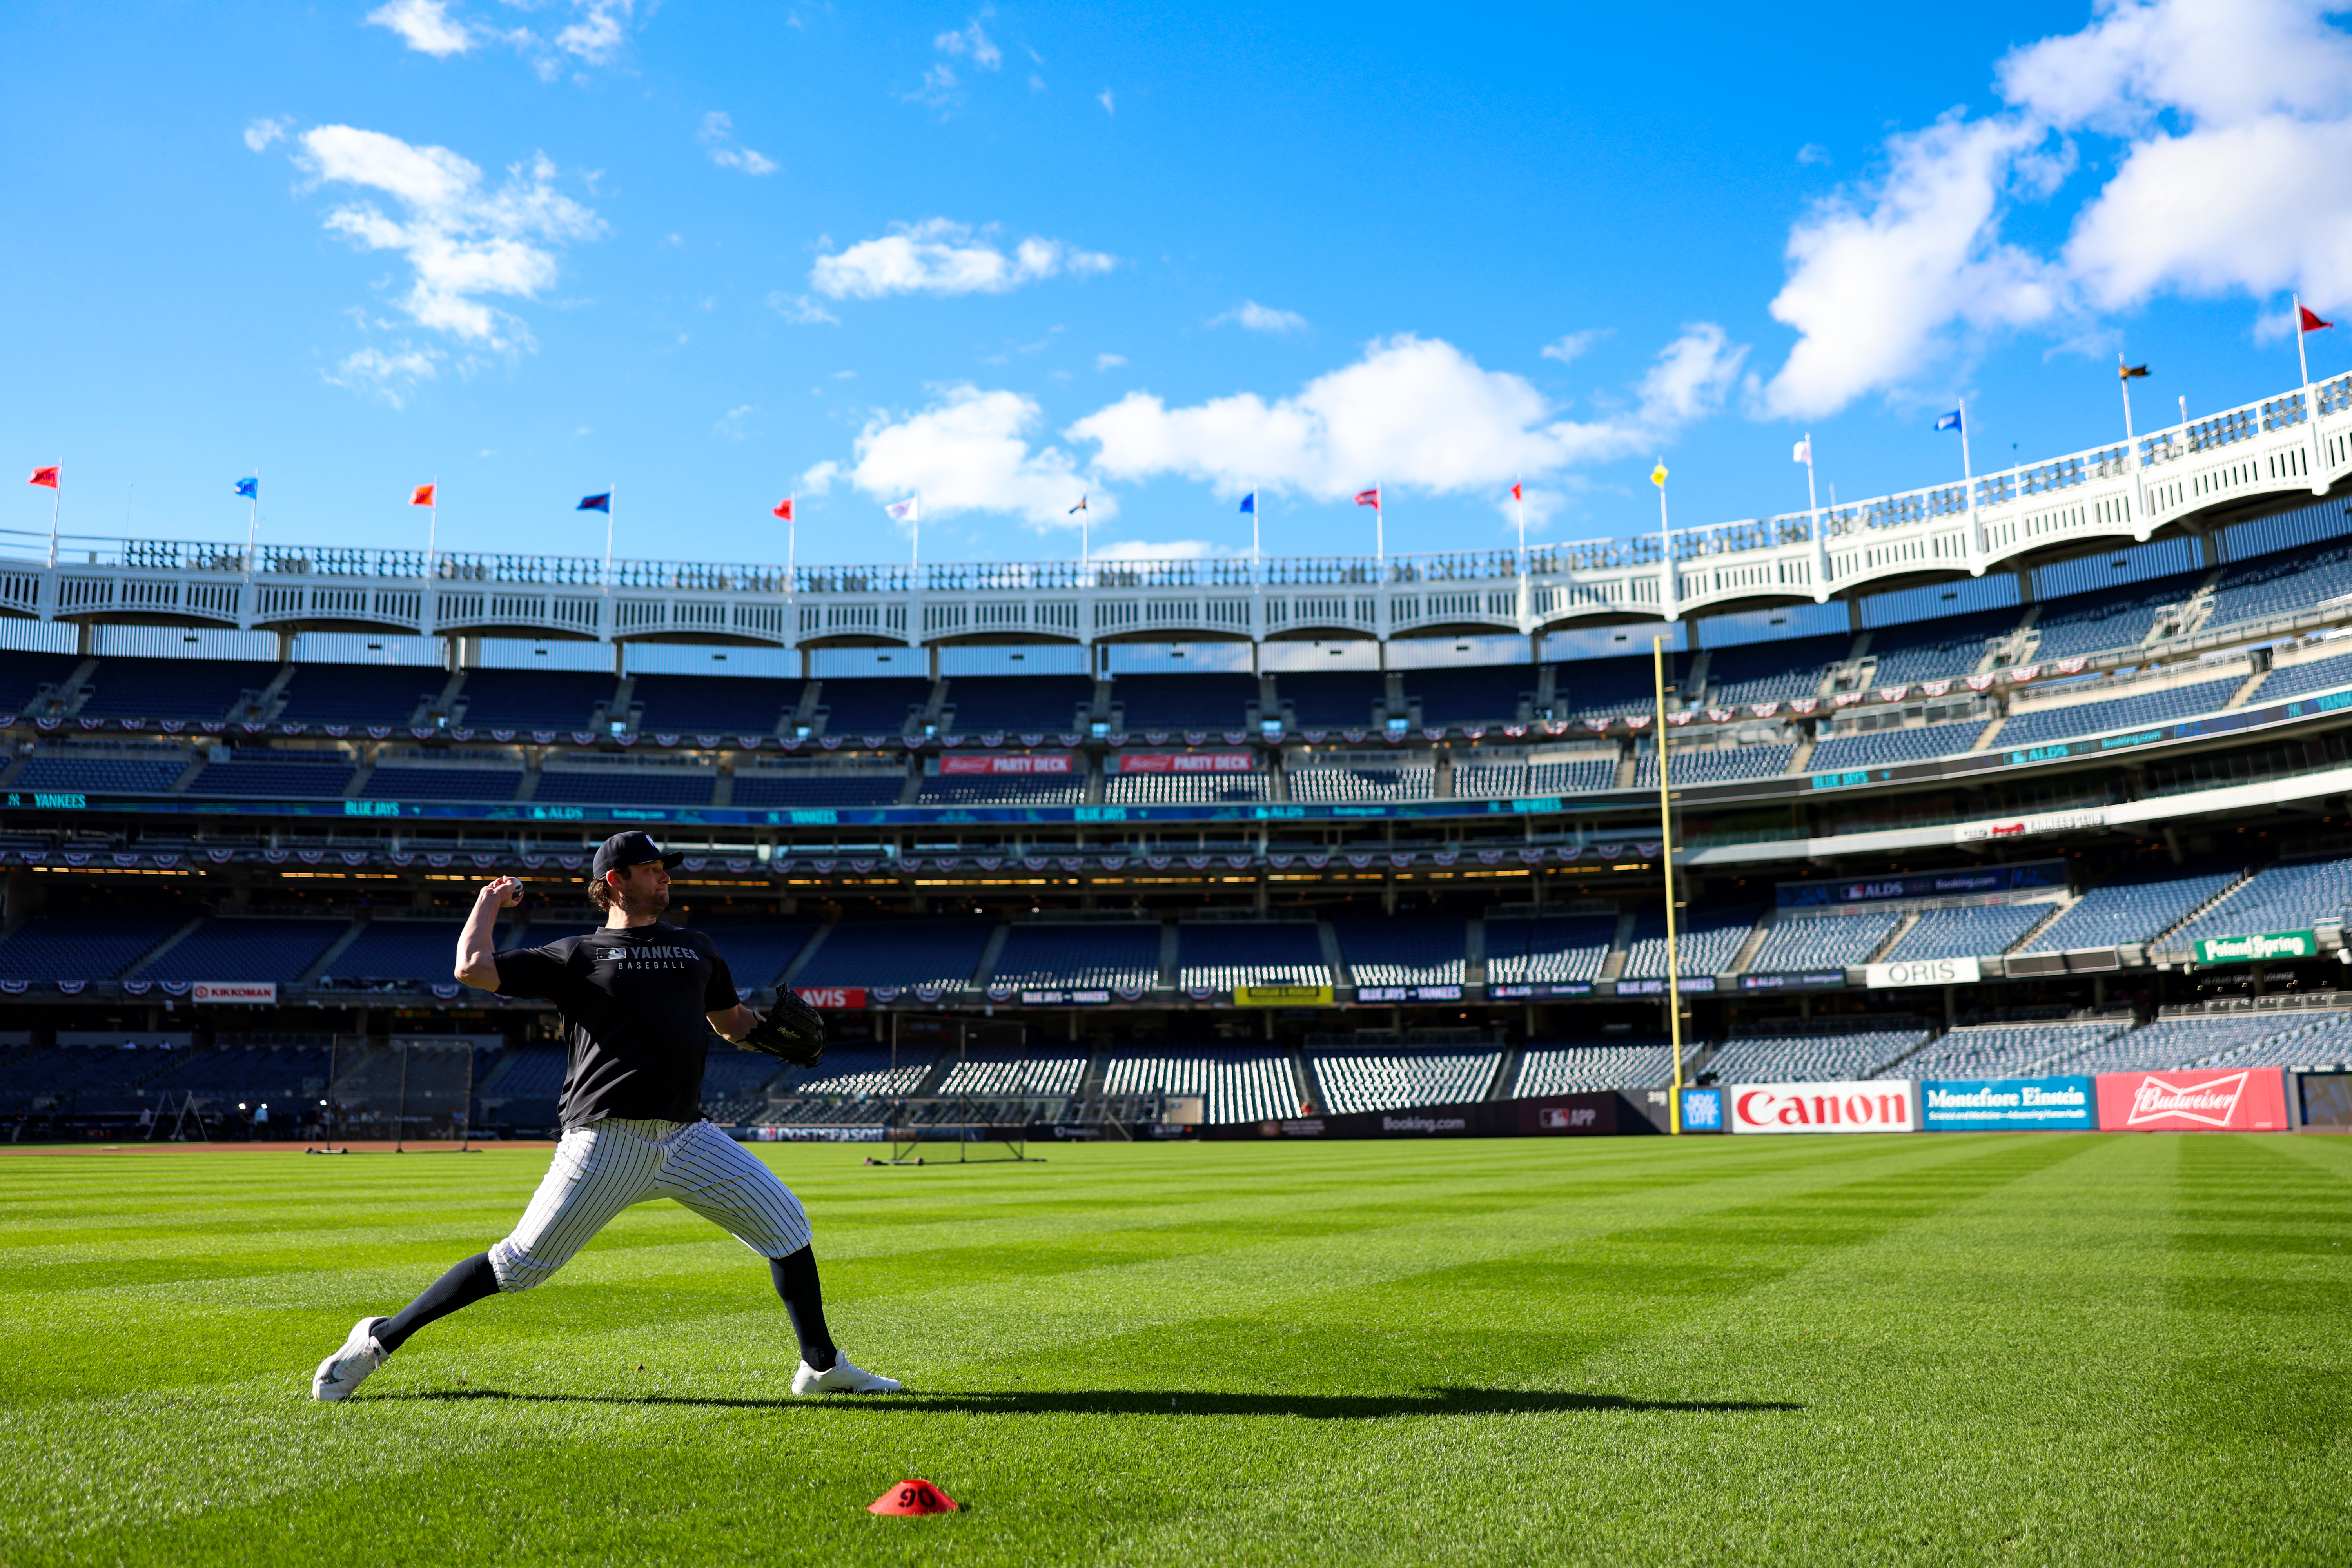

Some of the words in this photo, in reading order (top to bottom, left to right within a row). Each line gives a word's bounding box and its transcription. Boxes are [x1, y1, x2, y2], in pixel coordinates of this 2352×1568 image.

[2101, 730, 2163, 749] Booking.com
[2028, 744, 2069, 762] ALDS
[992, 757, 1032, 773] PARTY
[1033, 757, 1068, 773] DECK
[1174, 755, 1214, 771] PARTY
[1215, 755, 1250, 771] DECK
[34, 793, 86, 809] YANKEES
[345, 800, 373, 816] BLUE
[374, 801, 400, 817] JAYS
[549, 806, 584, 820] ALDS
[612, 808, 666, 821] Booking.com
[790, 809, 838, 824] YANKEES
[2025, 815, 2074, 833] YANKEES
[2074, 812, 2104, 828] CLUB
[1864, 881, 1904, 898] ALDS
[1935, 876, 1996, 889] Booking.com
[630, 946, 699, 960] YANKEES
[2204, 936, 2254, 960] Poland
[2253, 935, 2305, 958] Spring
[619, 961, 684, 969] BASEBALL
[1889, 961, 1955, 983] ORIS
[212, 987, 271, 997] KIKKOMAN
[1358, 987, 1384, 1000] BLUE
[1384, 987, 1407, 1000] JAYS
[1417, 986, 1461, 1000] YANKEES
[1617, 981, 1641, 995] BLUE
[1642, 980, 1663, 993] JAYS
[802, 989, 846, 1007] AVIS
[1022, 991, 1043, 1003] BLUE
[1044, 991, 1063, 1003] JAYS
[1072, 991, 1110, 1003] YANKEES
[1688, 1094, 1716, 1104] NEW
[1927, 1087, 2020, 1107] Montefiore
[2021, 1086, 2085, 1106] Einstein
[2135, 1087, 2235, 1112] Budweiser
[1684, 1103, 1719, 1115] YORK
[1737, 1091, 1905, 1126] Canon
[1928, 1111, 1955, 1120] Science
[1955, 1111, 1968, 1120] and
[2044, 1110, 2065, 1118] Human
[2066, 1109, 2087, 1118] Health
[1383, 1116, 1465, 1133] Booking.com
[1569, 1108, 1596, 1127] APP
[1688, 1112, 1716, 1125] LIFE
[777, 1128, 884, 1141] POSTSEASON
[898, 1488, 936, 1508] 90
